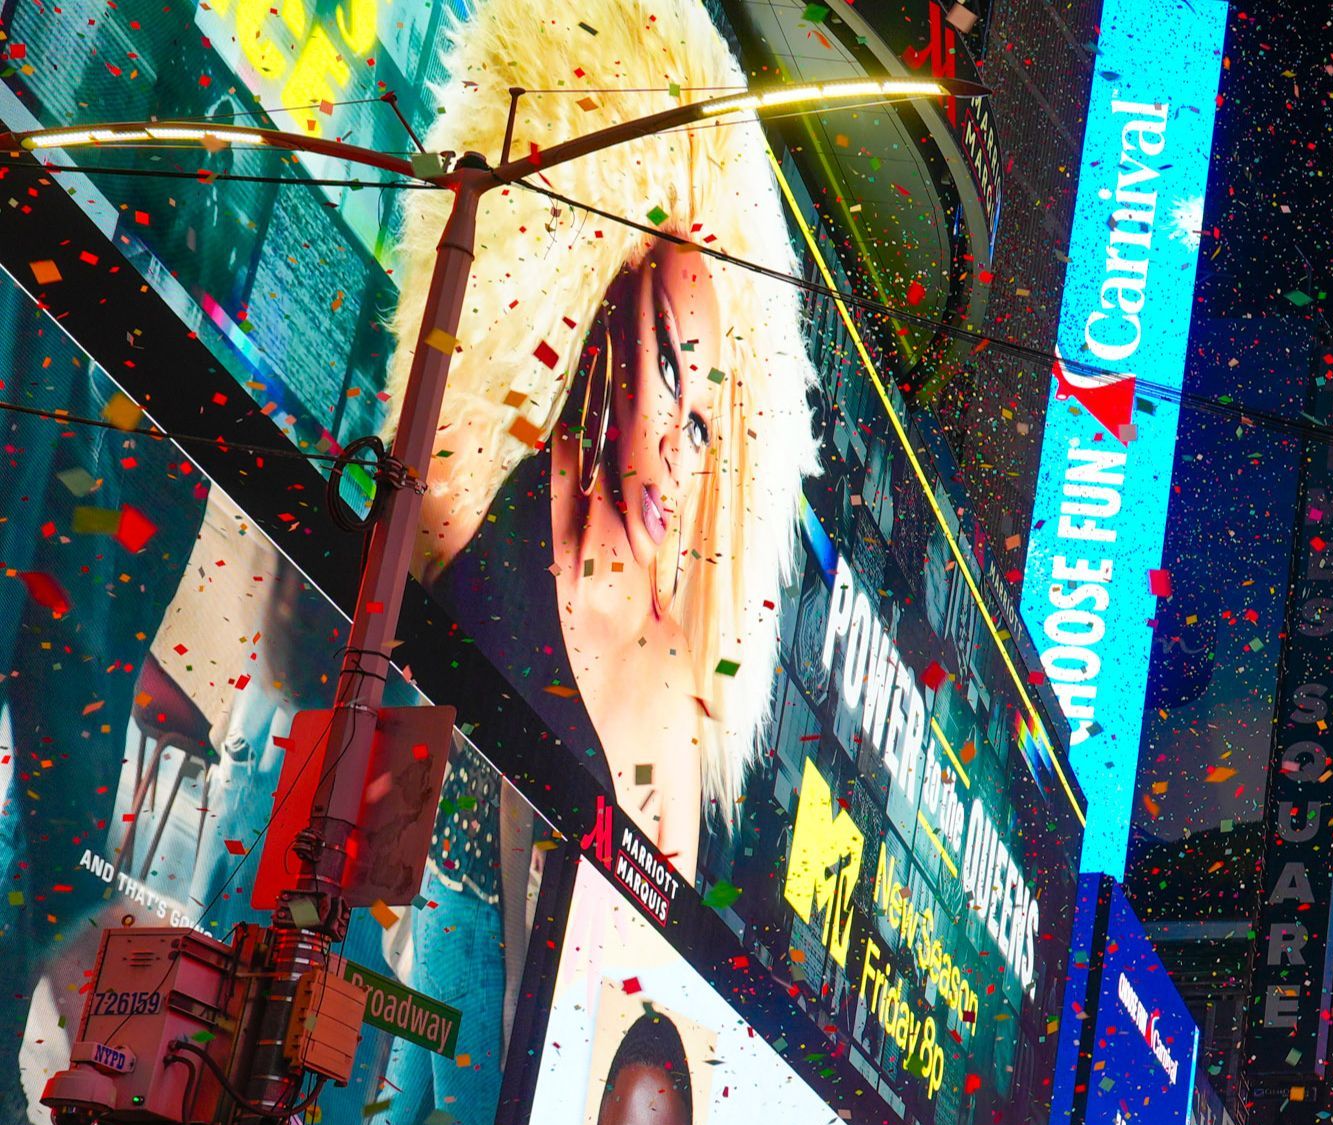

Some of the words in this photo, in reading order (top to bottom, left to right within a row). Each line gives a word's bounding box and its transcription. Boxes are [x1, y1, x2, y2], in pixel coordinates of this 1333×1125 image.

[1083, 100, 1170, 361] Carnival
[1058, 449, 1127, 542] FUN
[988, 560, 1024, 641] MARRIOTT
[822, 554, 926, 806] POWER
[962, 797, 1040, 1004] QUEENS
[79, 849, 115, 884] AND
[116, 872, 169, 920] THAT'S
[616, 856, 669, 922] MARQUIS
[621, 827, 679, 900] MARRIOTT
[1263, 683, 1330, 1028] SQUARE
[873, 840, 921, 950] New
[918, 907, 980, 1037] Season
[859, 936, 922, 1071] Friday
[94, 1042, 127, 1071] NYPD
